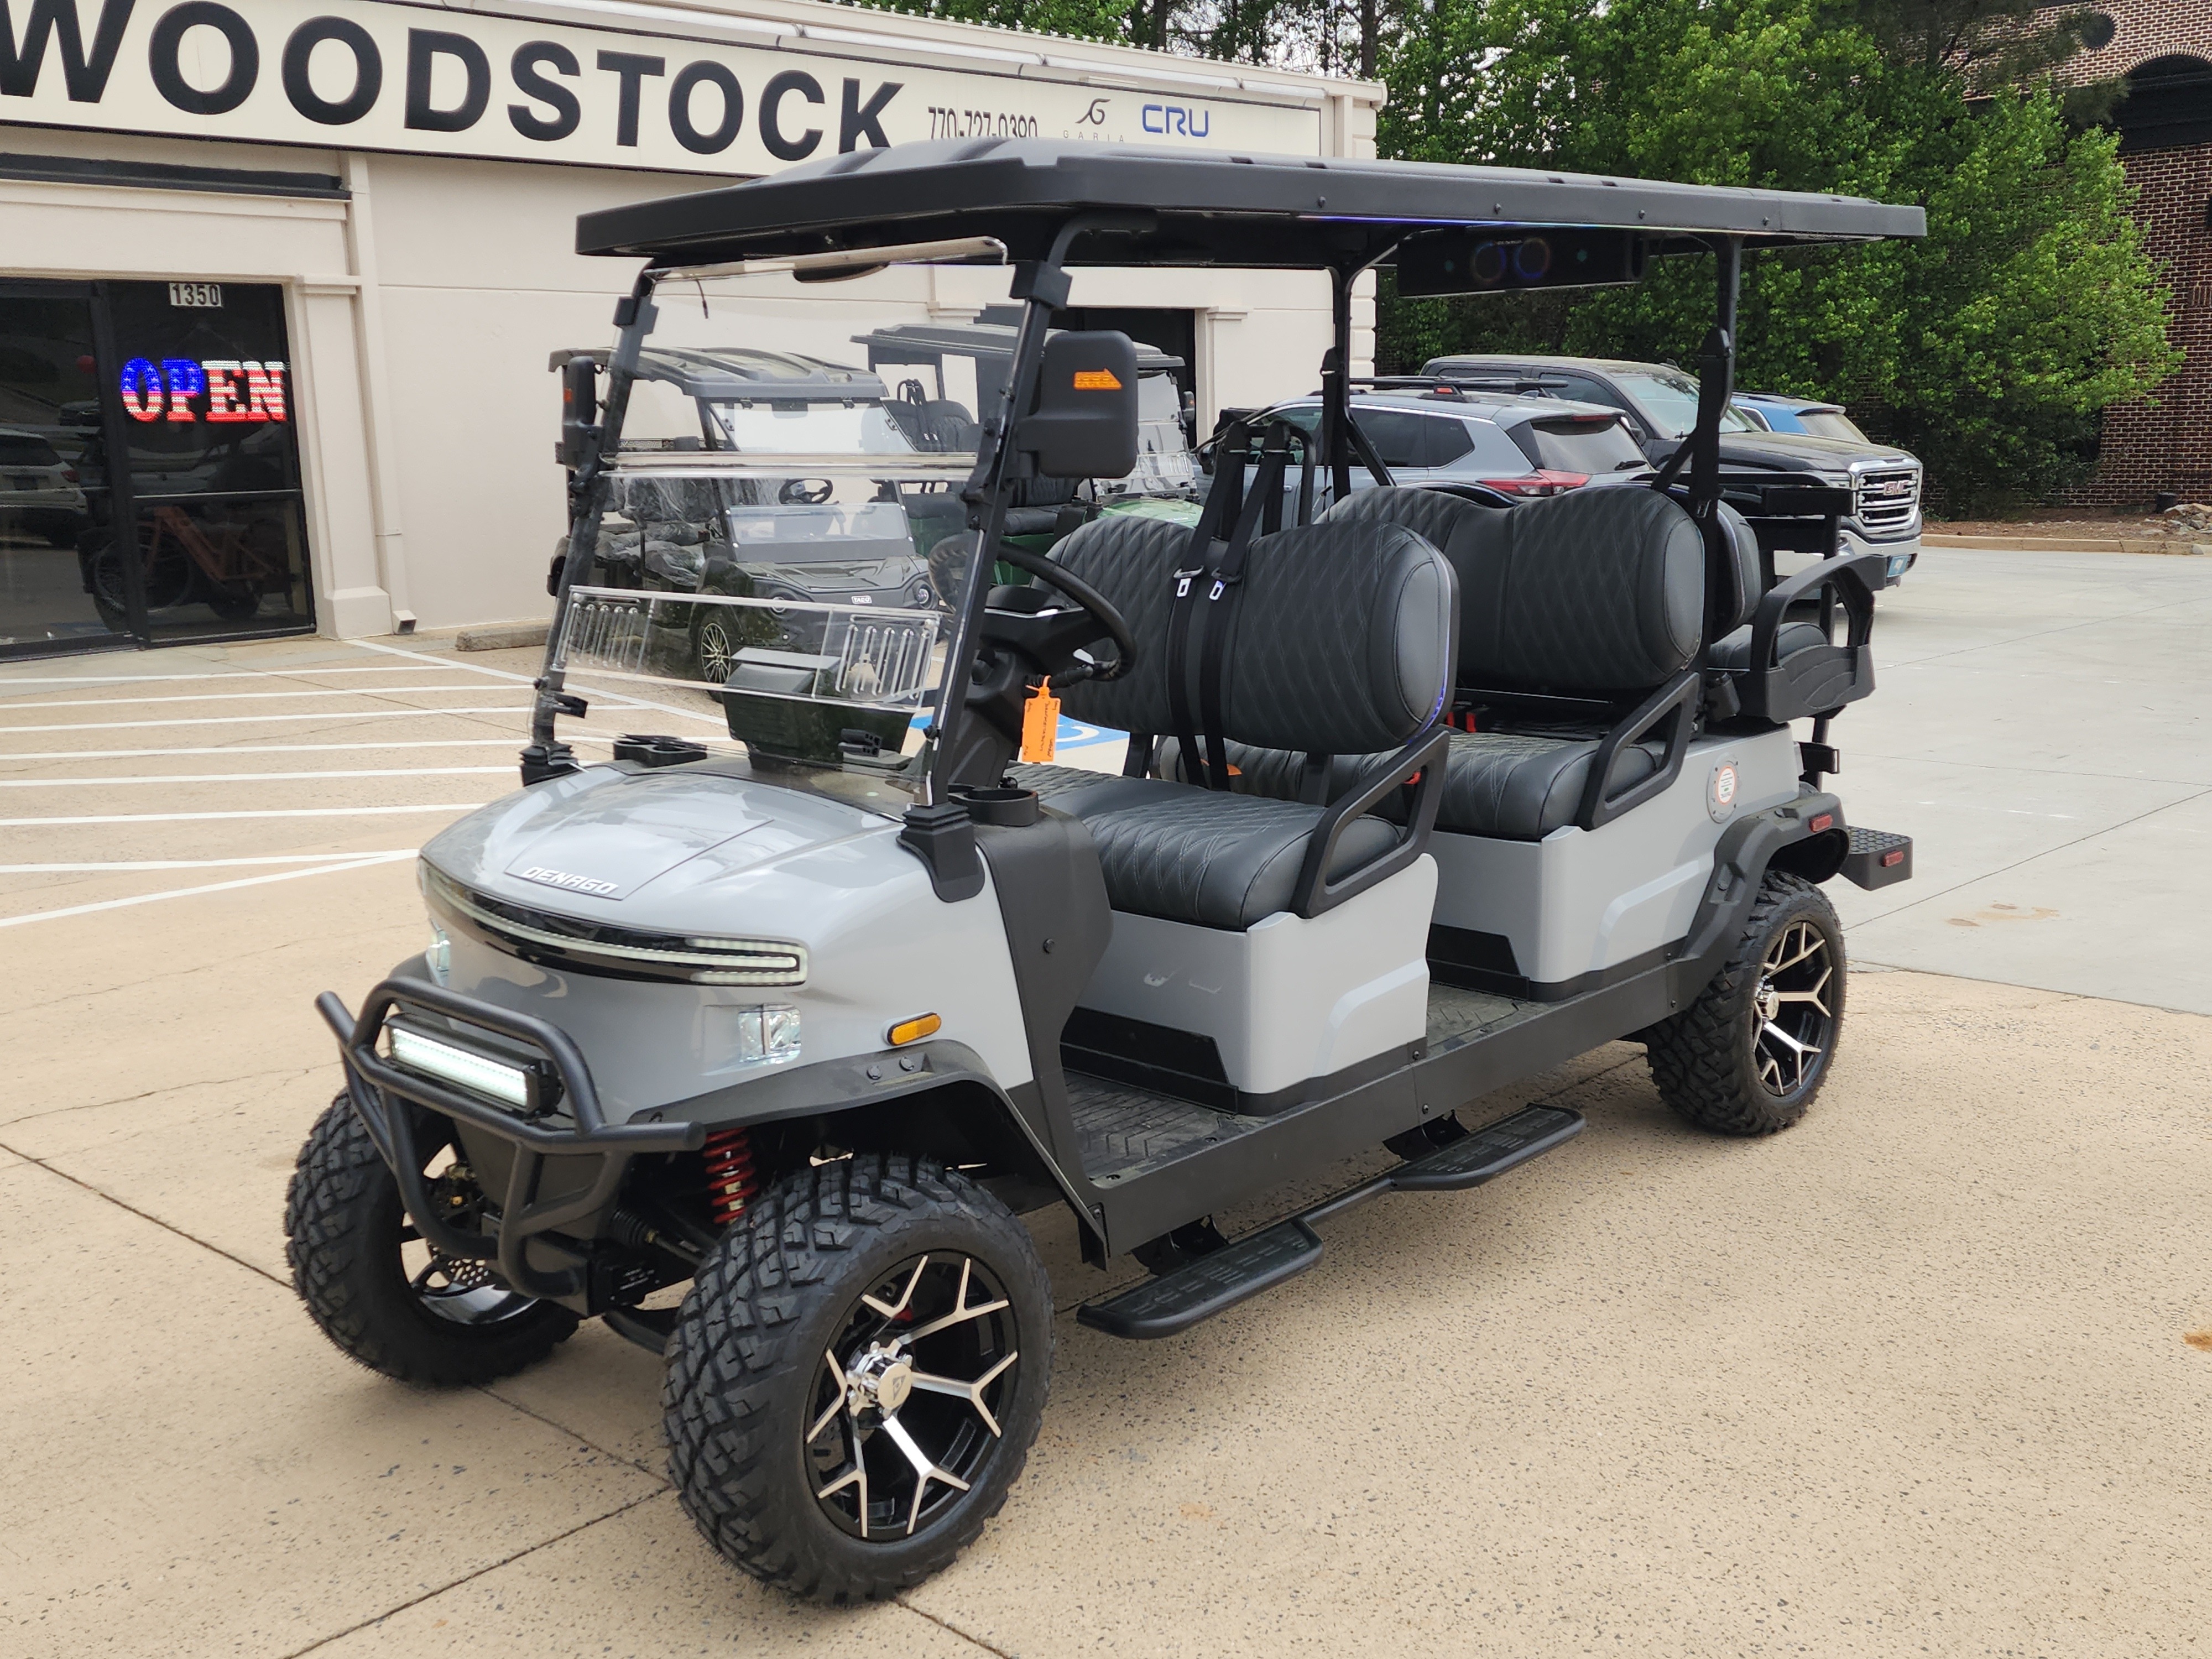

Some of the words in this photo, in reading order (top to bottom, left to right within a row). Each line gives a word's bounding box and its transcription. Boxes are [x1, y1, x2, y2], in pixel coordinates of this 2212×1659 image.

[0, 0, 905, 160] WOODSTOCK
[1142, 103, 1209, 138] CRU
[1063, 129, 1124, 142] GARIA
[173, 283, 219, 305] 1350
[121, 357, 288, 422] OPEN
[1884, 479, 1911, 495] GMC
[521, 866, 619, 895] DENAGO
